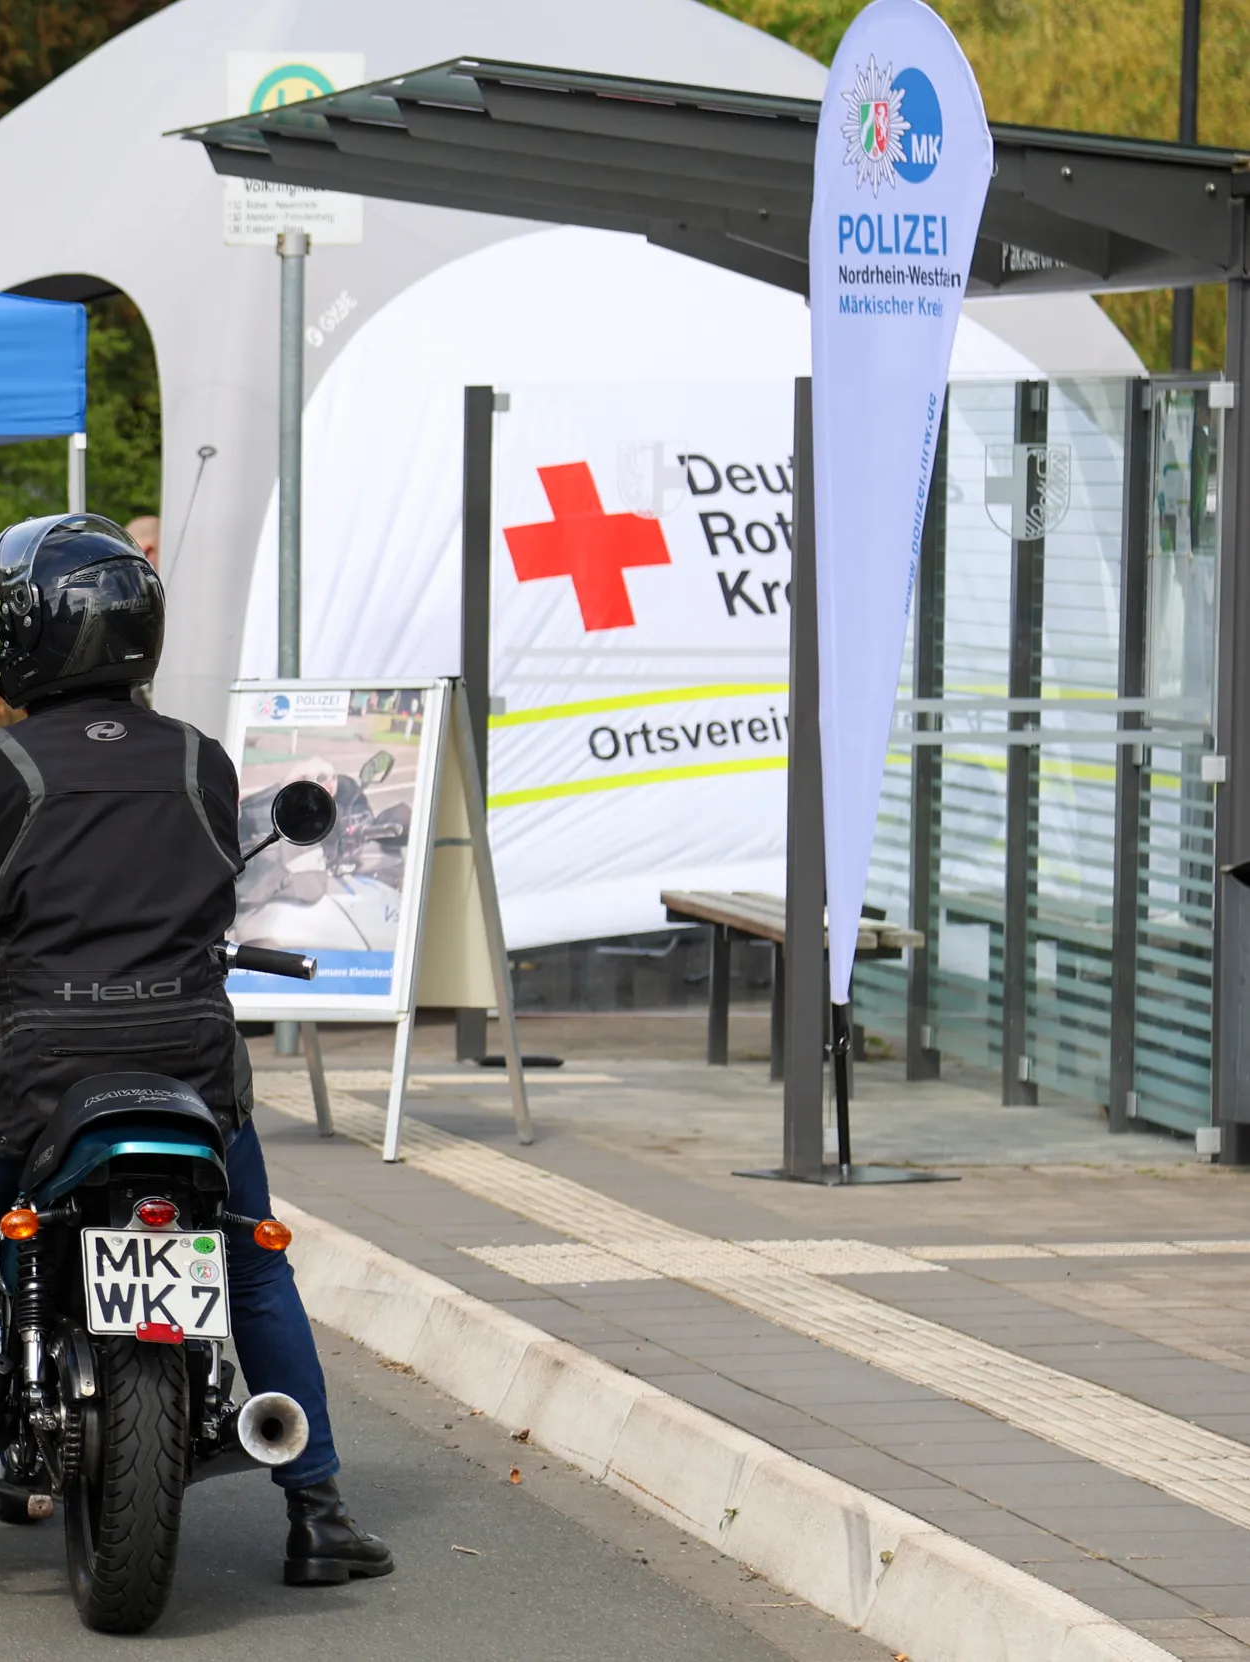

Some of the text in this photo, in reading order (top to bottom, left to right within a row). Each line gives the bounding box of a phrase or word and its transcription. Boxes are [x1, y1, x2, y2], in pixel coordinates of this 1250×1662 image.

[910, 133, 941, 165] MK
[838, 213, 948, 257] POLIZEI
[839, 294, 915, 315] Märkischer
[295, 695, 341, 706] POLIZEI
[588, 706, 790, 761] Ortsverei
[53, 976, 182, 1002] Held
[318, 968, 348, 978] unsere
[94, 1236, 182, 1279] MK
[93, 1282, 221, 1329] WK 7
